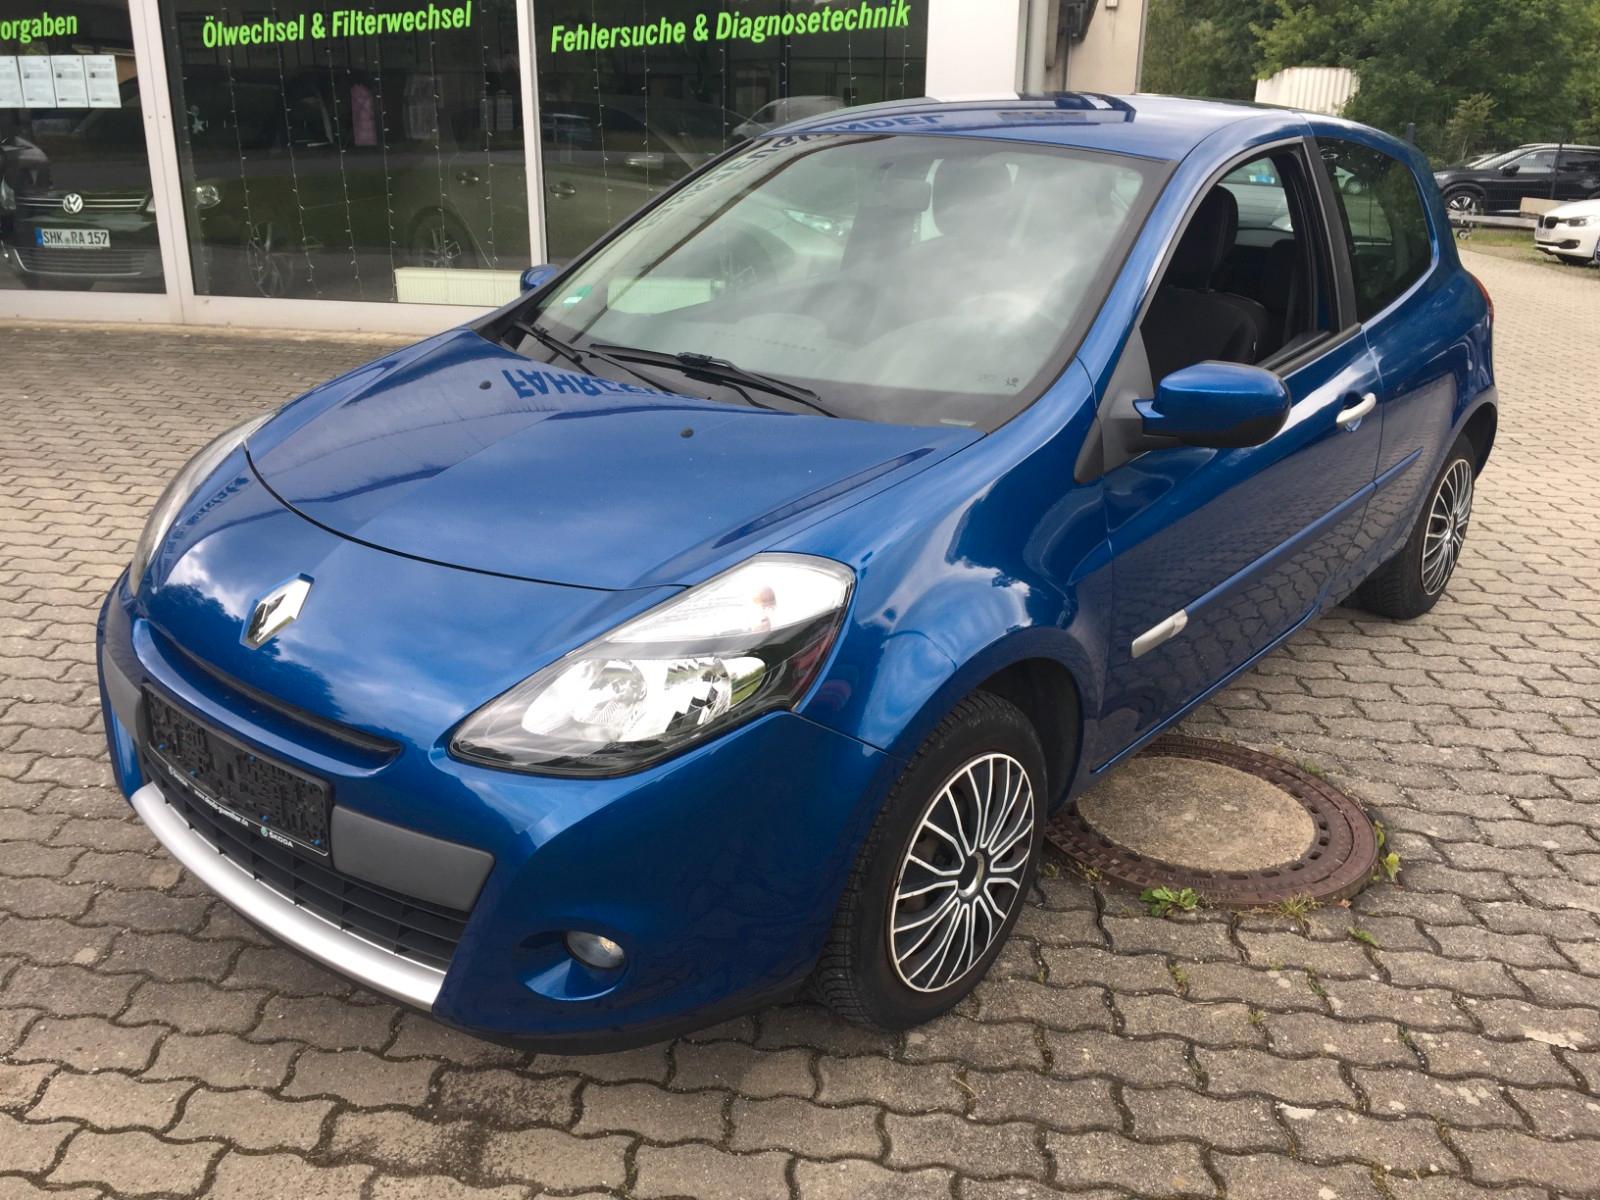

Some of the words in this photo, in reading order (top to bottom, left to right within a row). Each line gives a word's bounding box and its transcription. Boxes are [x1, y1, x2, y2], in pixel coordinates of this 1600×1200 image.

[0, 11, 78, 44] orgaben
[202, 14, 305, 48] Ölwechsel
[311, 13, 326, 39] &
[332, 0, 472, 37] Filterwechsel
[551, 17, 686, 52] Fehlersuche
[693, 13, 709, 42] &
[716, 1, 911, 43] Diagnosetechnik
[43, 231, 63, 245] SHK
[70, 231, 86, 245] RA
[87, 231, 108, 245] 157
